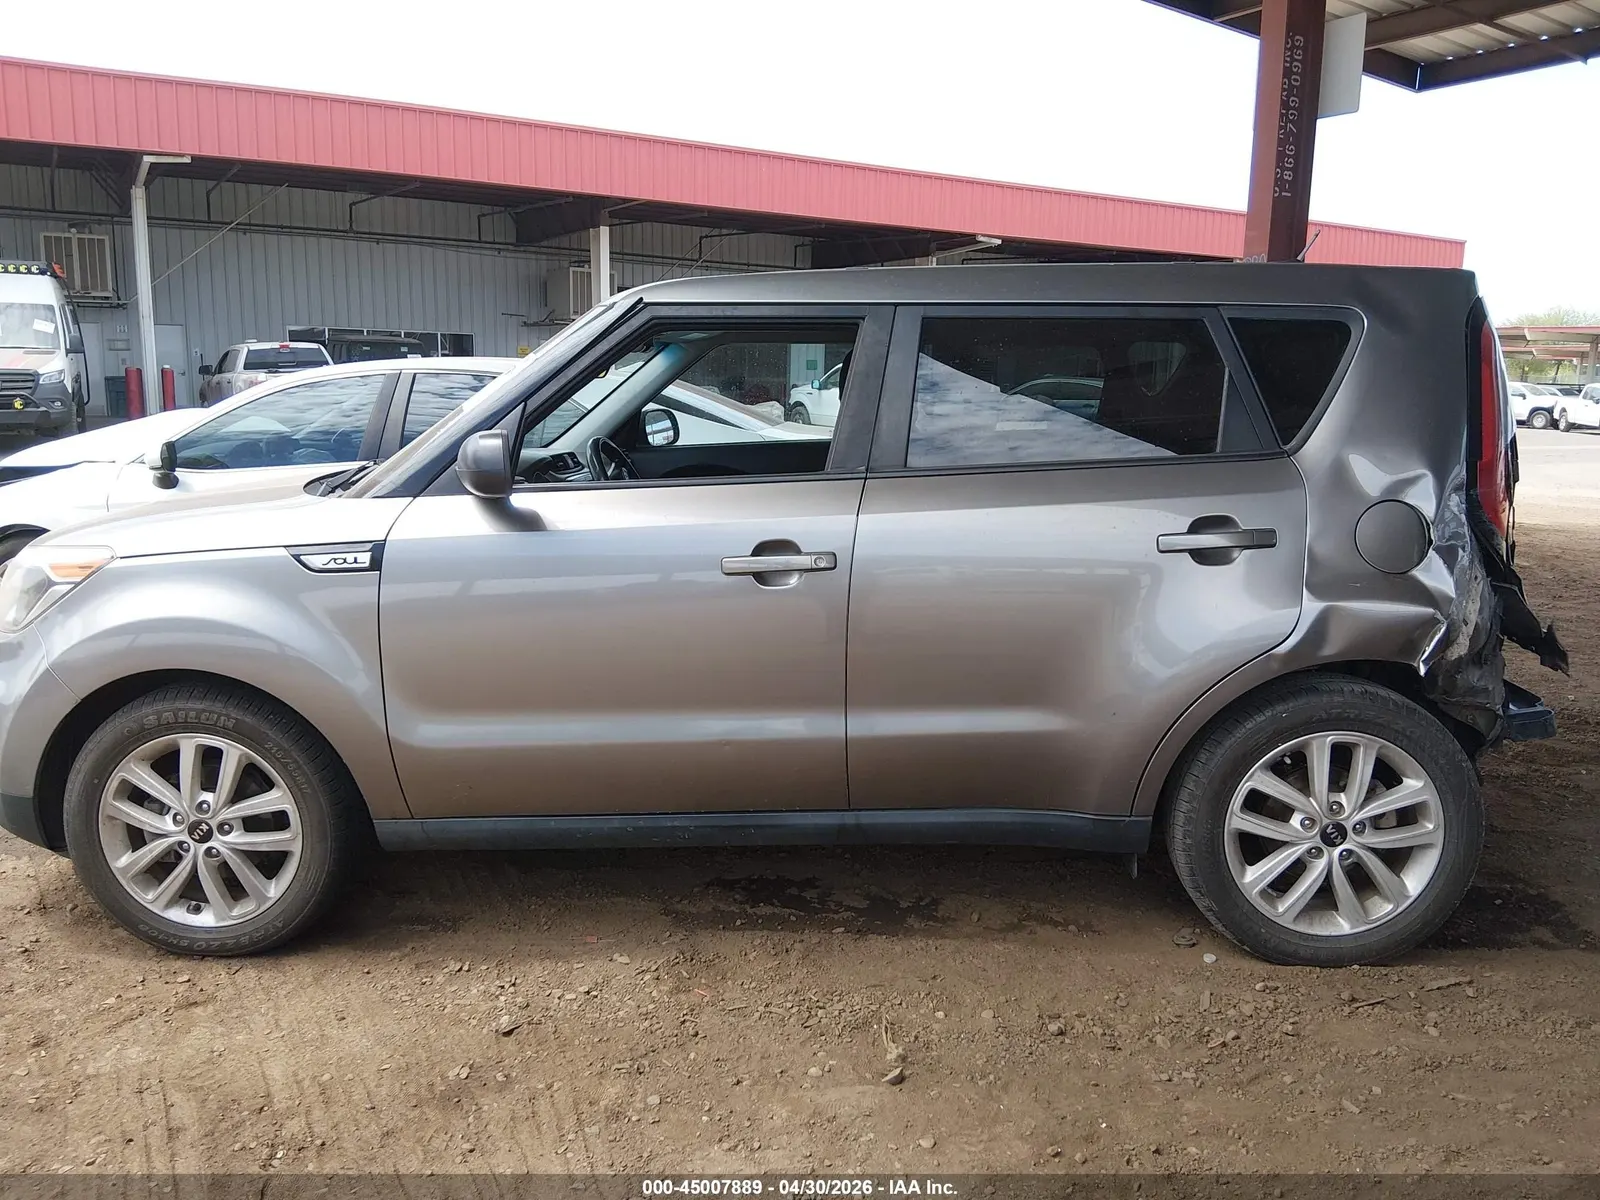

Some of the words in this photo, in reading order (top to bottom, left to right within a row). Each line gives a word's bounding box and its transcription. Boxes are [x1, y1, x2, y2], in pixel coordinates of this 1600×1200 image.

[1282, 35, 1304, 197] 1-866-799-0969
[143, 711, 236, 730] SAILUN
[190, 822, 210, 840] KIA
[1326, 824, 1344, 846] KIA
